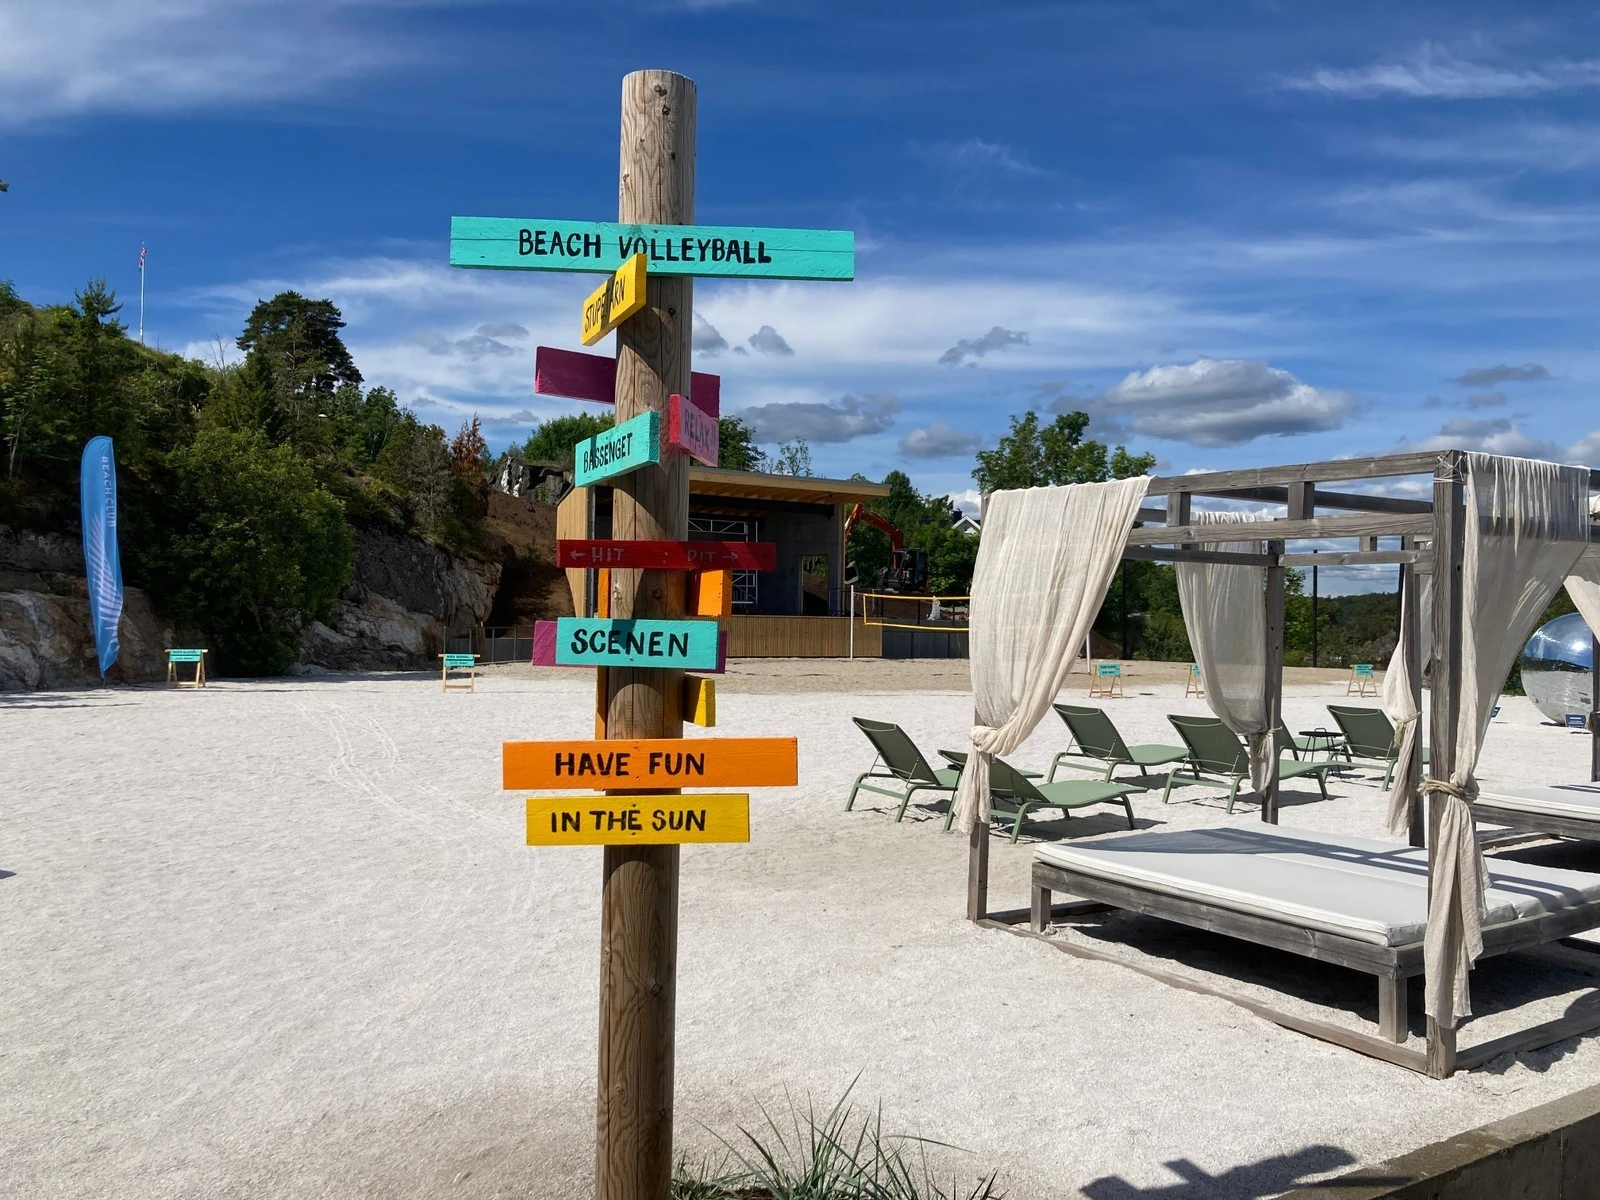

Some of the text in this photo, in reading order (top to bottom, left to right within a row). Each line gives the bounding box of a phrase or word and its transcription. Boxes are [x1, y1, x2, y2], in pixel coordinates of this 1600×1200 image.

[519, 228, 772, 264] BEACH VOLLEYBALL
[583, 432, 633, 473] BASSENGET
[101, 456, 116, 528] BEACH CLUB
[591, 546, 625, 563] HIT
[570, 628, 689, 658] SCENEN
[555, 752, 705, 776] HAVE FUN
[551, 809, 707, 833] IN THE SUN
